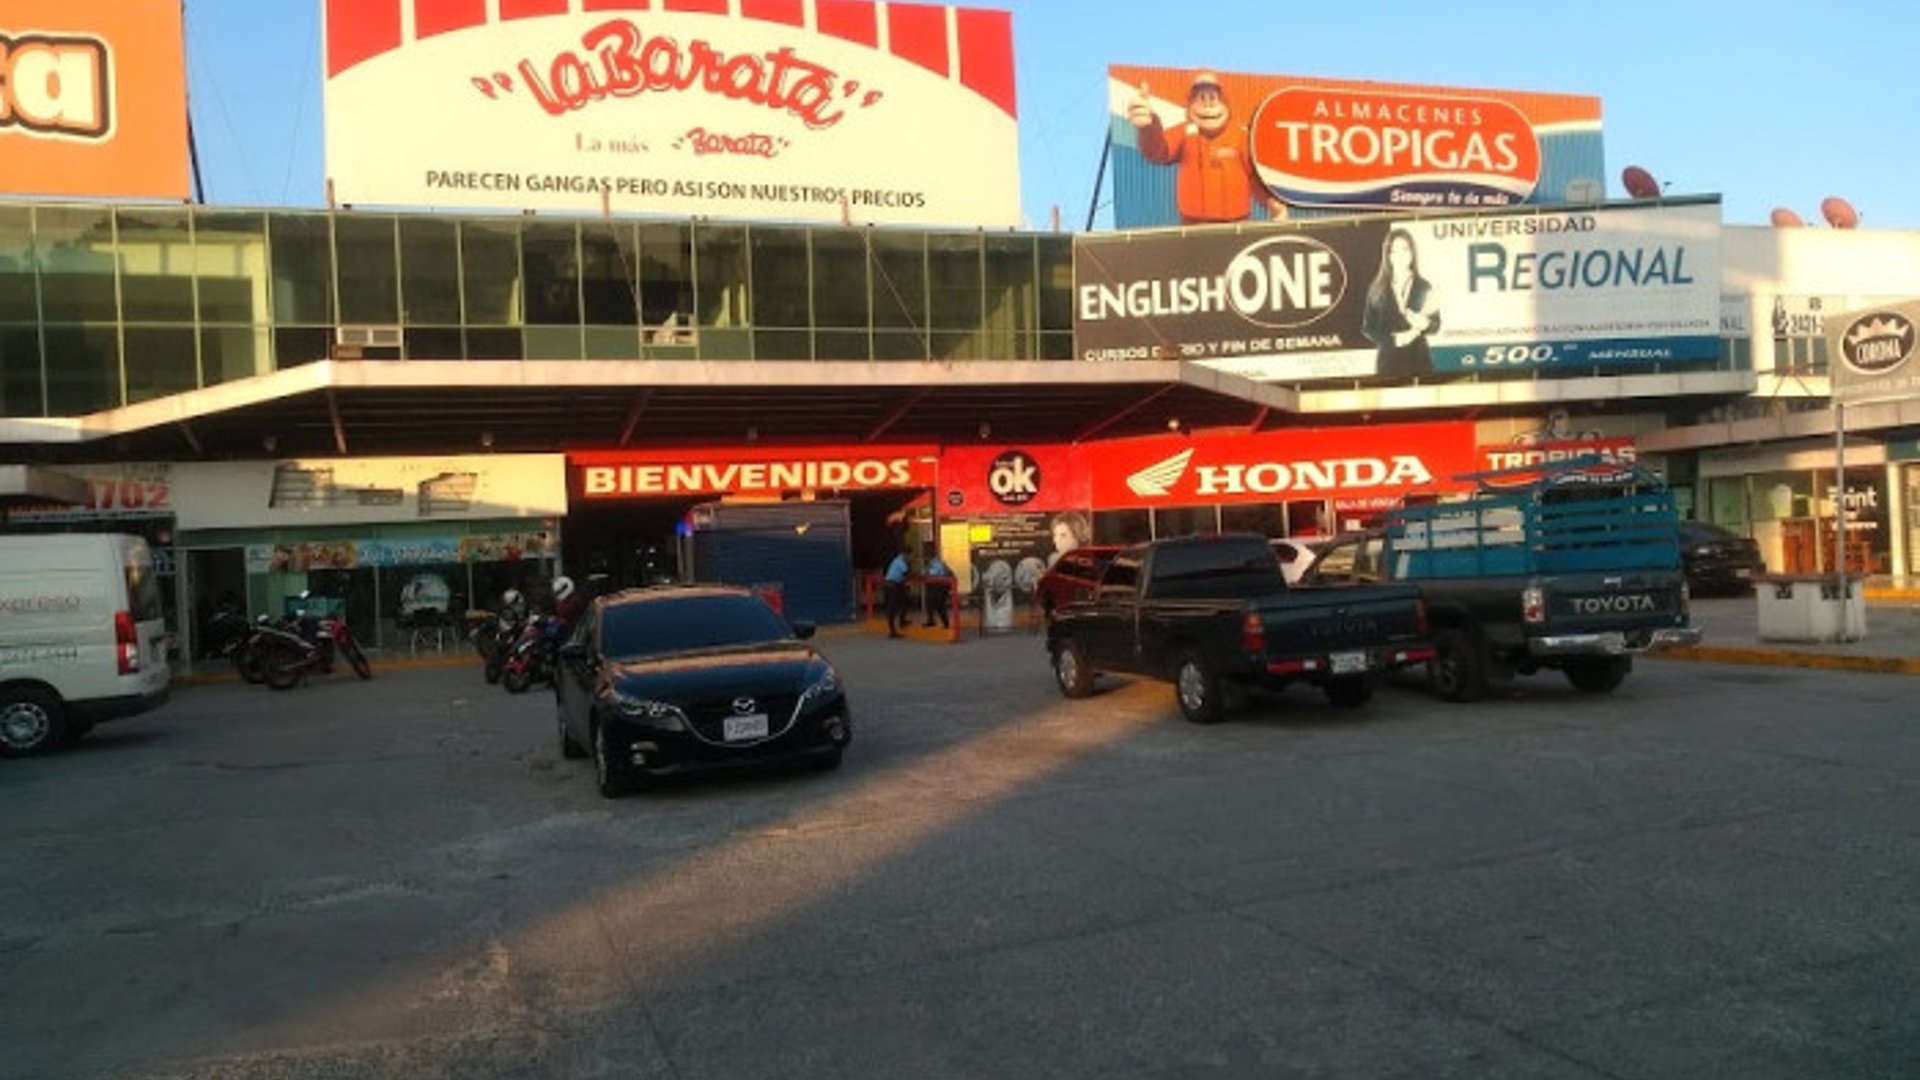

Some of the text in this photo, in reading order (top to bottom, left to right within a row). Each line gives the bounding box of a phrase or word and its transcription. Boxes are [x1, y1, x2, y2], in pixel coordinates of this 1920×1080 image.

[1314, 99, 1483, 126] ALMACENES
[576, 132, 602, 153] La
[1275, 119, 1518, 171] TROPIGAS
[426, 170, 520, 191] PARECEN
[526, 174, 611, 193] GANGAS
[616, 177, 668, 195] PERO
[750, 183, 847, 204] NUESTROS
[852, 189, 925, 208] PRECIOS
[1432, 214, 1596, 240] UNIVERSIDAD
[1467, 241, 1694, 294] REGIONAL
[1208, 343, 1218, 355] Y
[1221, 340, 1247, 354] FIN
[1250, 338, 1272, 353] DE
[1274, 333, 1343, 352] SEMANA
[584, 459, 911, 494] BIENVENIDOS
[1195, 455, 1433, 495] HONDA
[1571, 595, 1655, 613] TOYOTA
